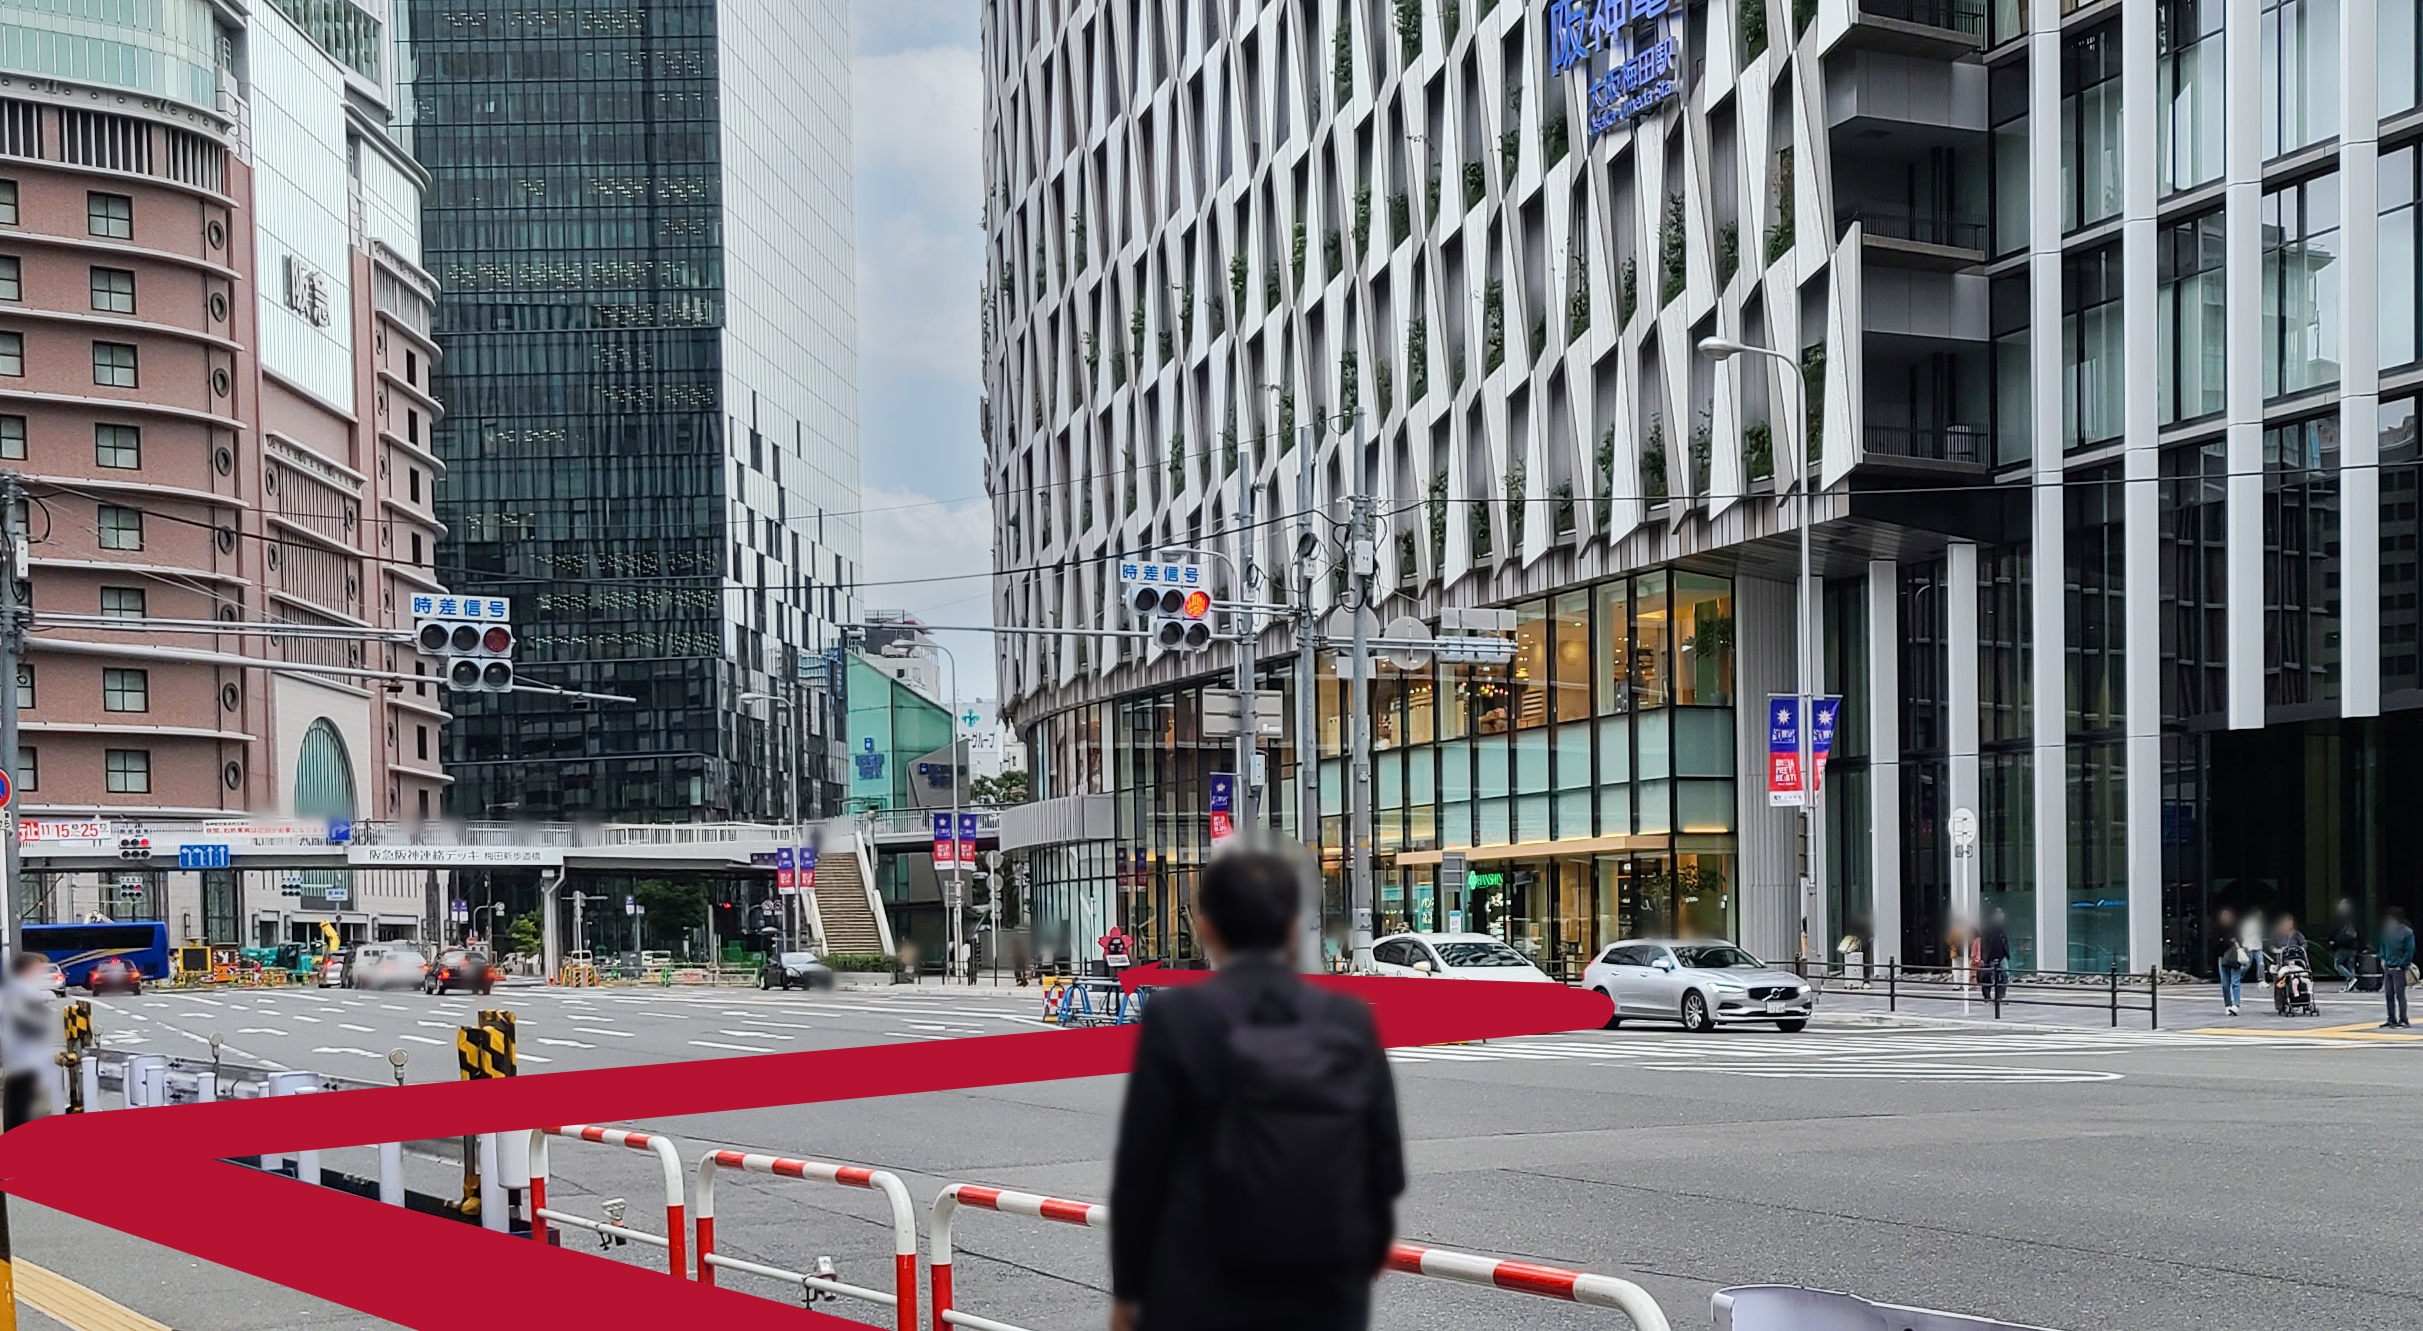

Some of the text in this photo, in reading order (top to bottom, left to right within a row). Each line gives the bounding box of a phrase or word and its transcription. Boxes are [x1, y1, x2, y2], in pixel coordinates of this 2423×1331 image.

[1588, 36, 1675, 112] 大阪梅田駅
[290, 254, 331, 327] 阪急
[1122, 564, 1200, 583] 時差信号
[414, 597, 506, 618] 時差信号
[369, 849, 541, 861] 阪急阪神連絡デッキ 梅田新歩道橋
